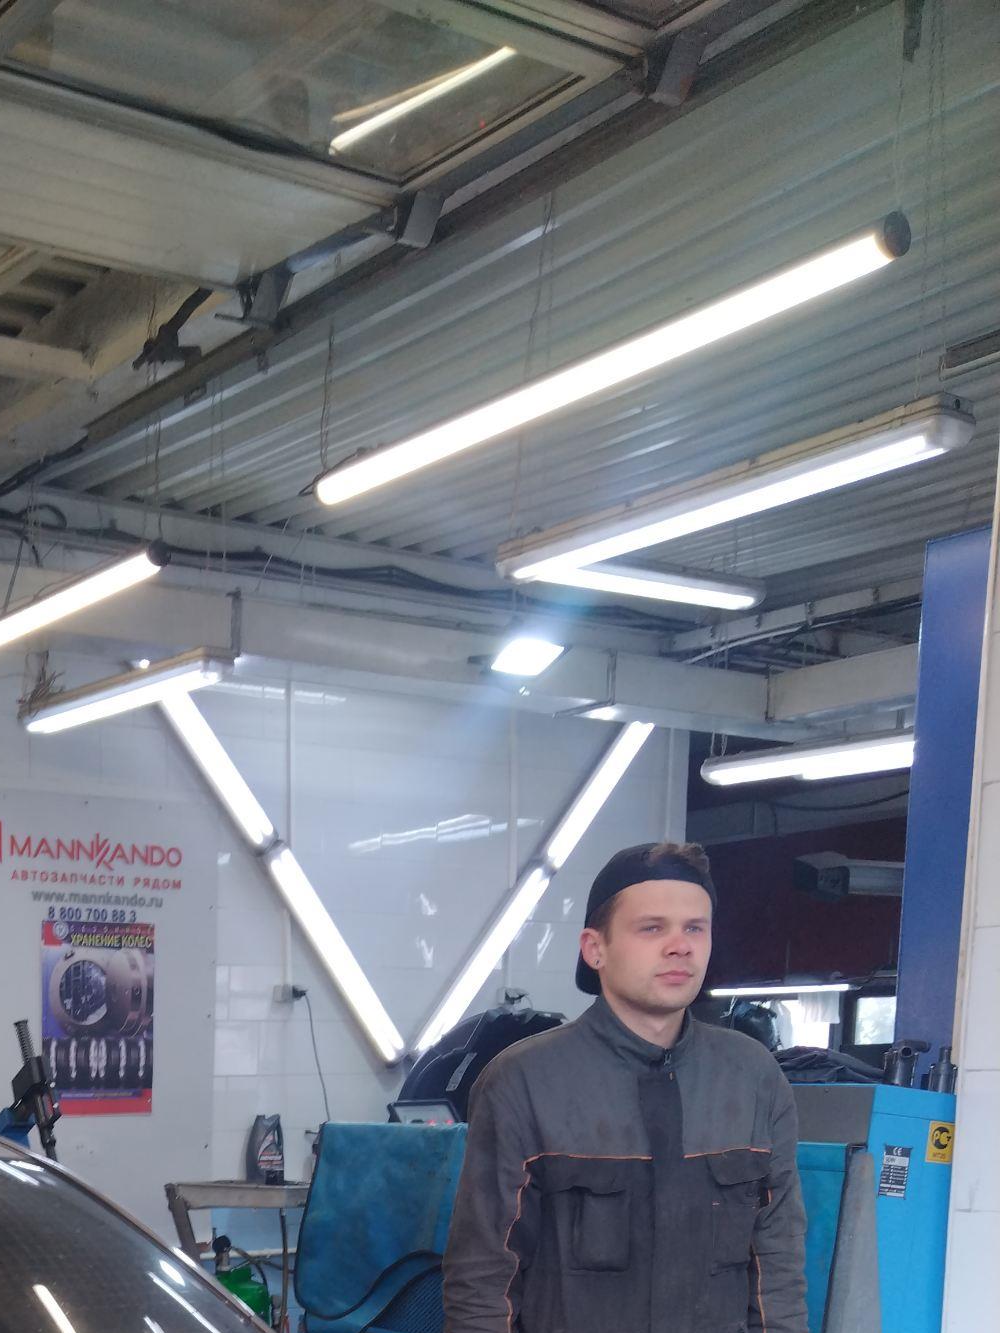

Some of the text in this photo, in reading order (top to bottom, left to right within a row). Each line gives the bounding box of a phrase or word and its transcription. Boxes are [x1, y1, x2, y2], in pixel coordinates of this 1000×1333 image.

[9, 832, 183, 871] MANNKANDO
[10, 869, 183, 891] АВТОЗАПЧАСТИ РЯДОМ
[59, 907, 82, 921] 800
[86, 908, 108, 922] 700
[70, 933, 121, 948] ХРАНЕНИЕ
